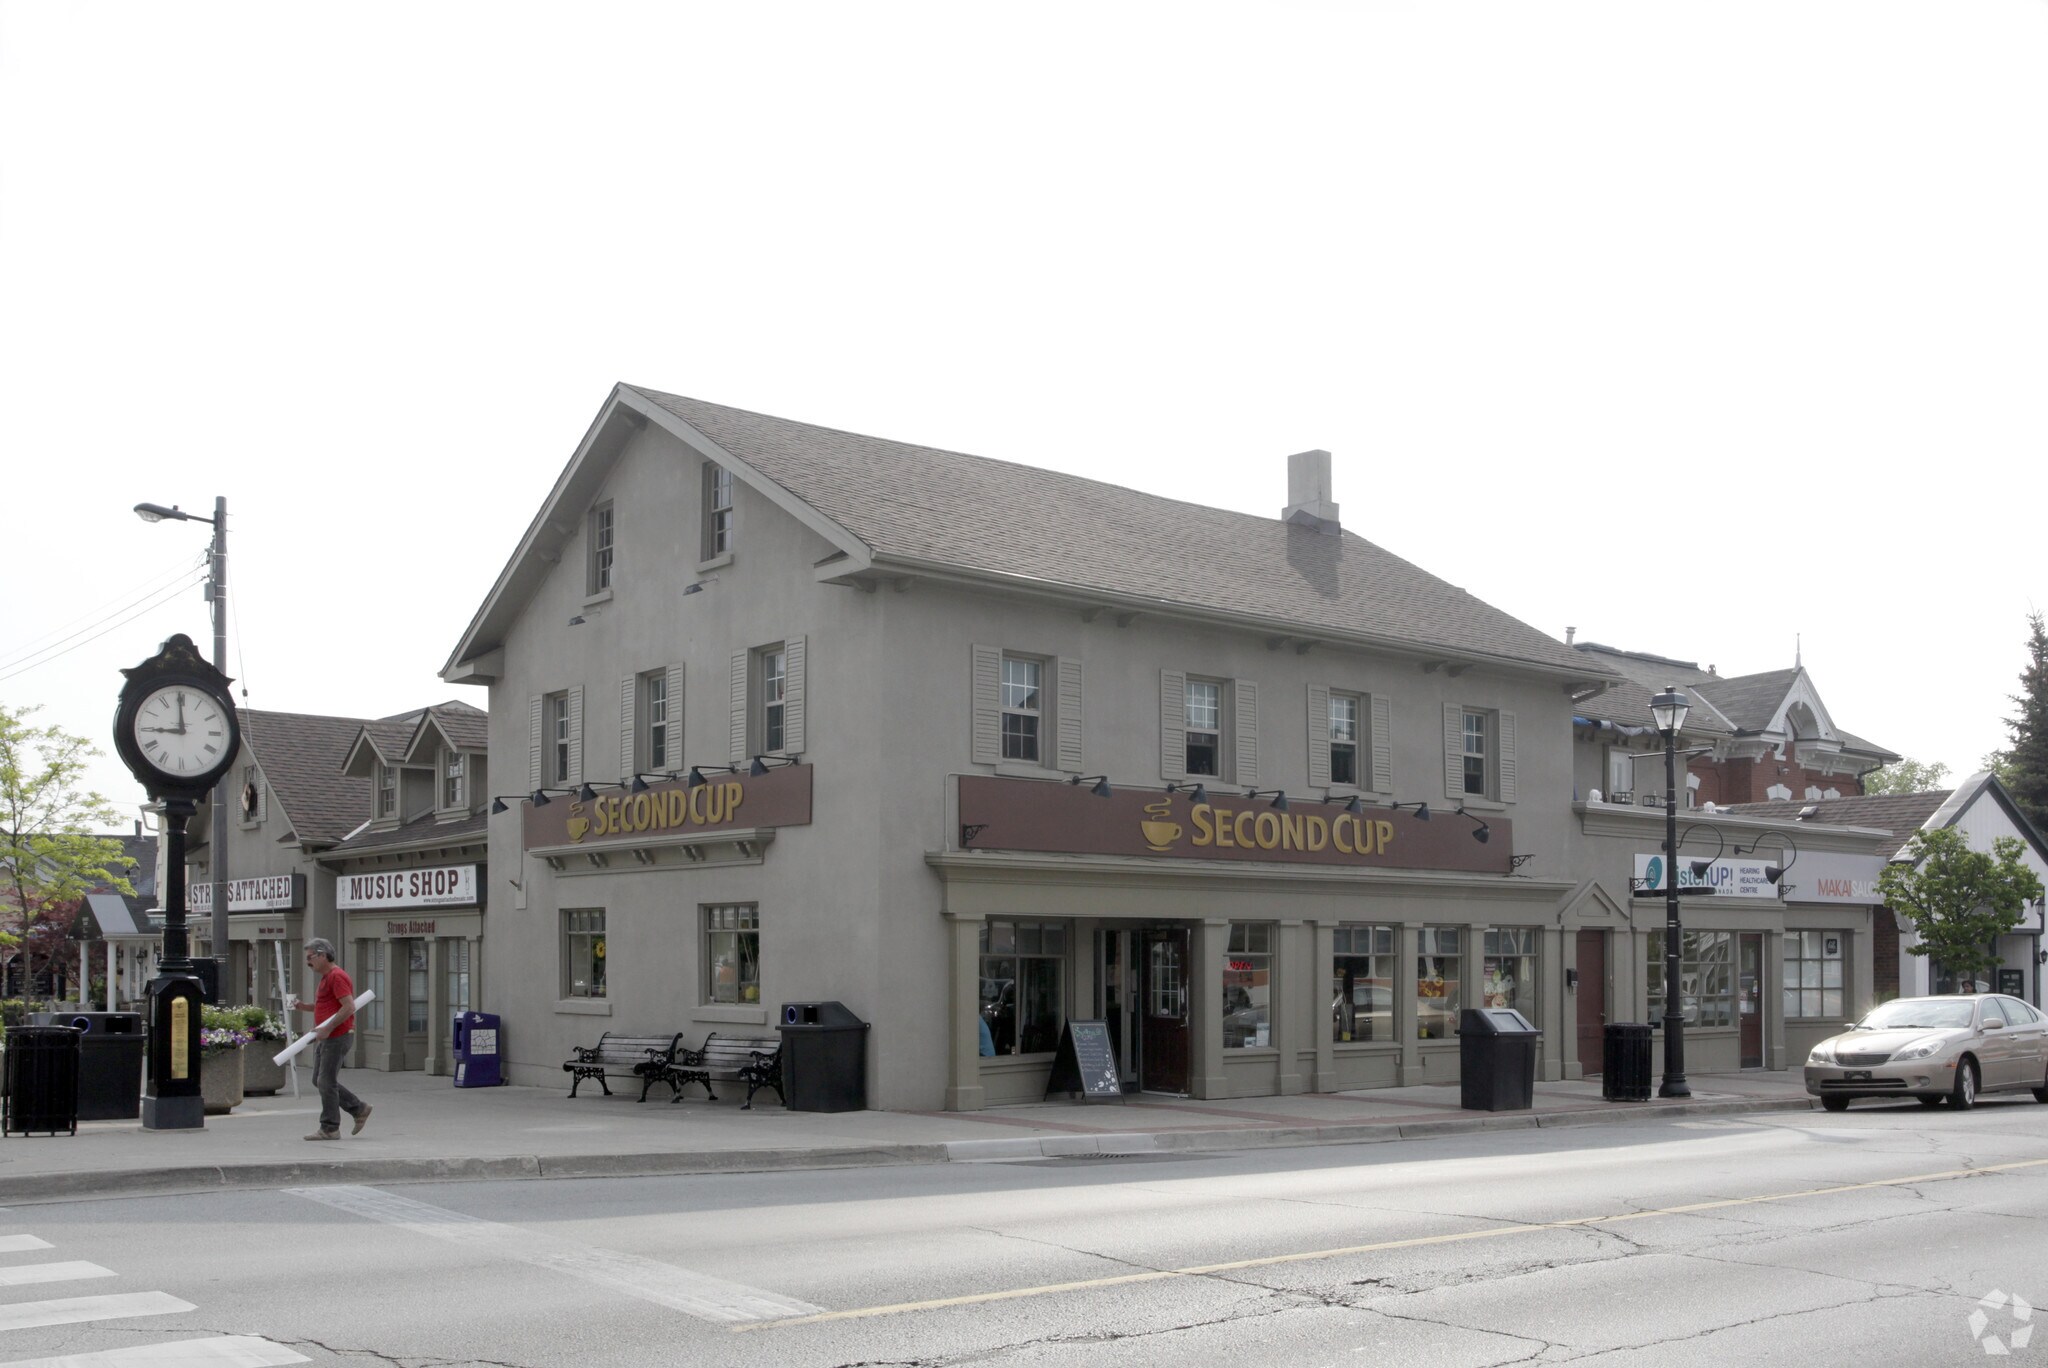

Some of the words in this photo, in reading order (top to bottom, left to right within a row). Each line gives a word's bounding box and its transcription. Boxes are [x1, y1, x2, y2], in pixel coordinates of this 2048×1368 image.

[594, 789, 687, 836] SECOND
[689, 782, 744, 825] CUP
[1190, 803, 1329, 852] SECOND
[1332, 813, 1394, 856] CUP
[350, 874, 403, 900] MUSIC
[410, 869, 459, 898] SHOP
[1674, 865, 1733, 887] istenUP!
[1740, 886, 1758, 894] CENTRE
[193, 882, 234, 905] STRS
[236, 877, 290, 902] ATTACHED
[387, 921, 408, 935] Strings
[409, 920, 436, 934] Attached
